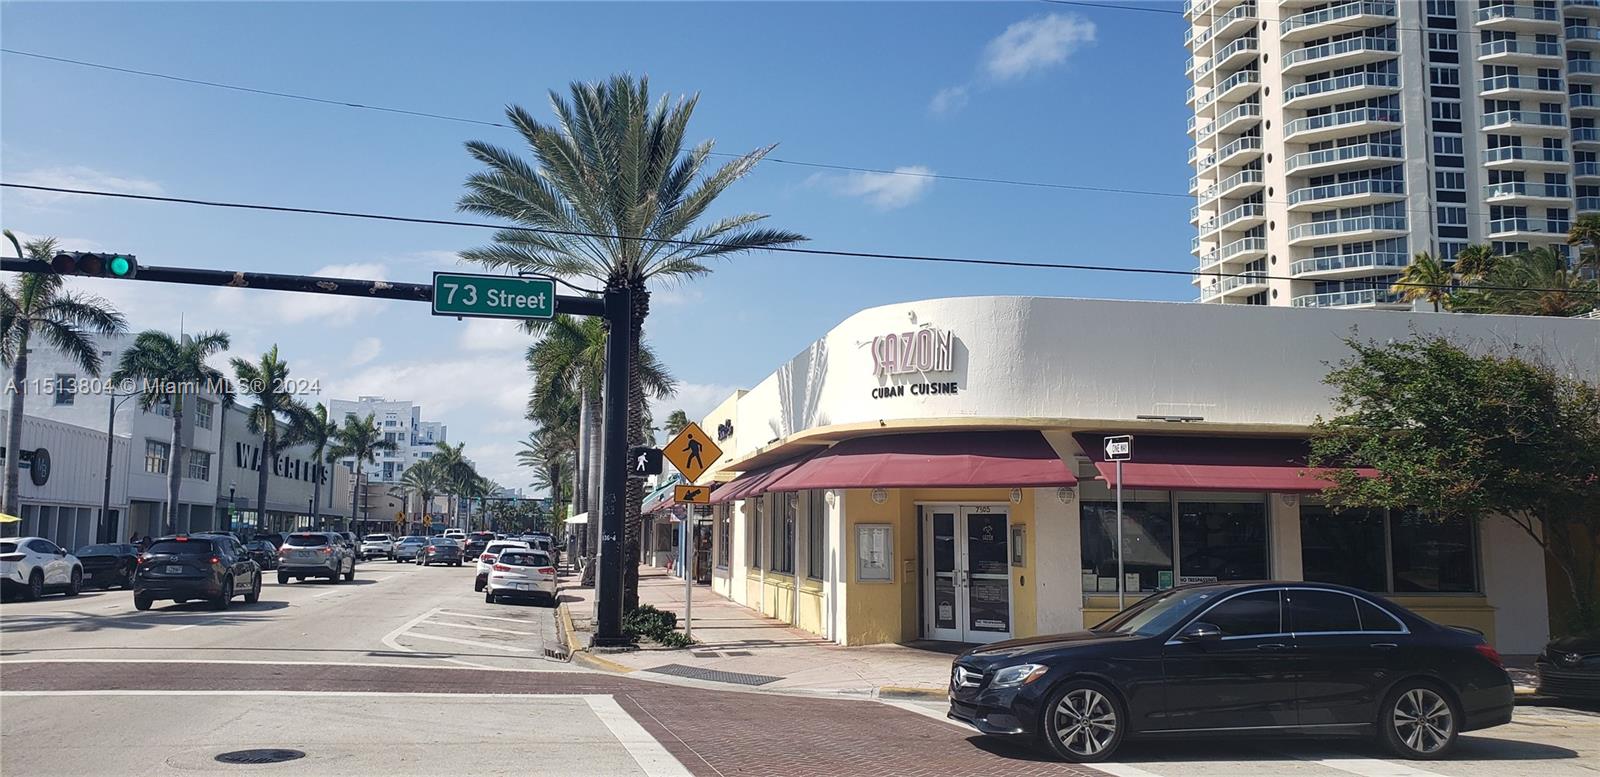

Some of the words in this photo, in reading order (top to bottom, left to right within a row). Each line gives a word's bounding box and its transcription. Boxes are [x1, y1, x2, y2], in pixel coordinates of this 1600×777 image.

[443, 283, 478, 306] 73
[486, 288, 546, 309] Street
[872, 385, 904, 399] CUBAN
[910, 382, 958, 395] CUISINE
